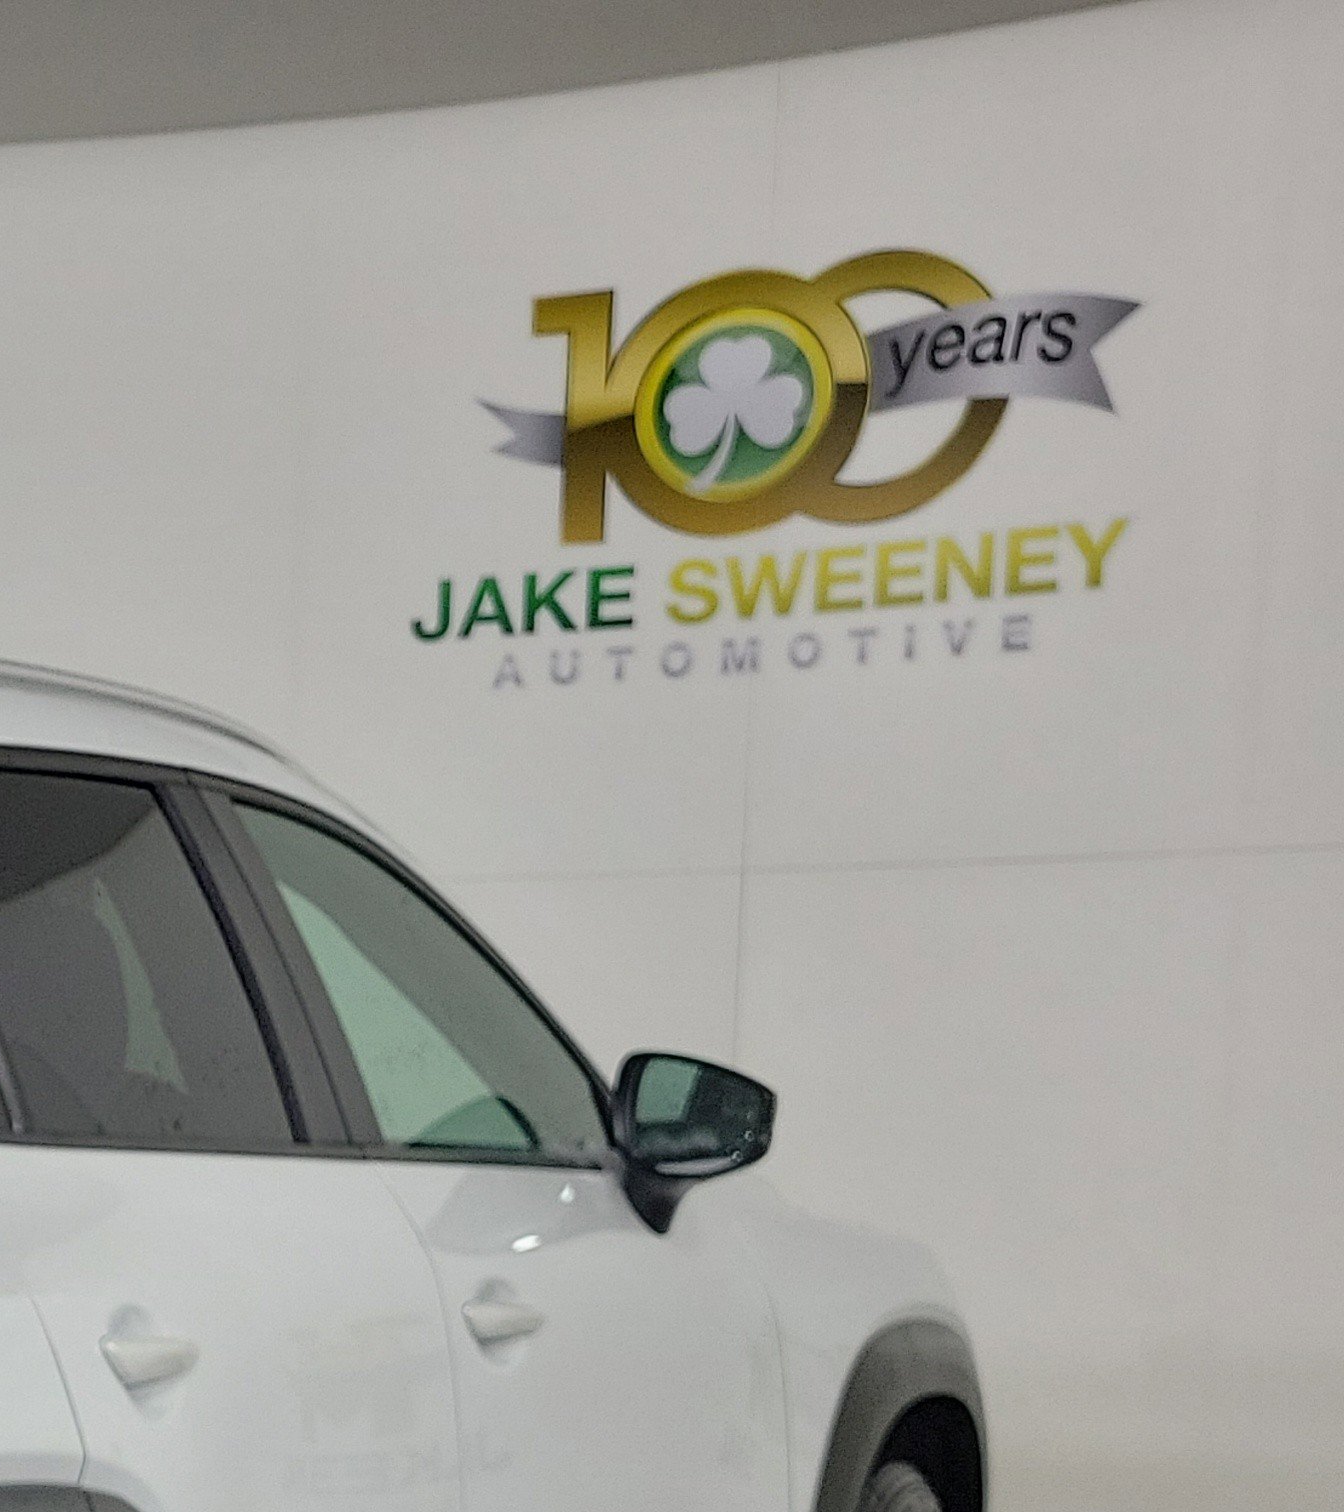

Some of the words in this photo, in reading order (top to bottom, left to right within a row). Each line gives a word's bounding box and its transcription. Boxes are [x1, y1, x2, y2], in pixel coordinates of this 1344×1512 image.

[531, 247, 1011, 547] 100
[884, 307, 1079, 399] years
[413, 564, 637, 645] JAKE
[665, 517, 1132, 627] SWEENEY
[491, 612, 1036, 692] AUTOMOTIVE
